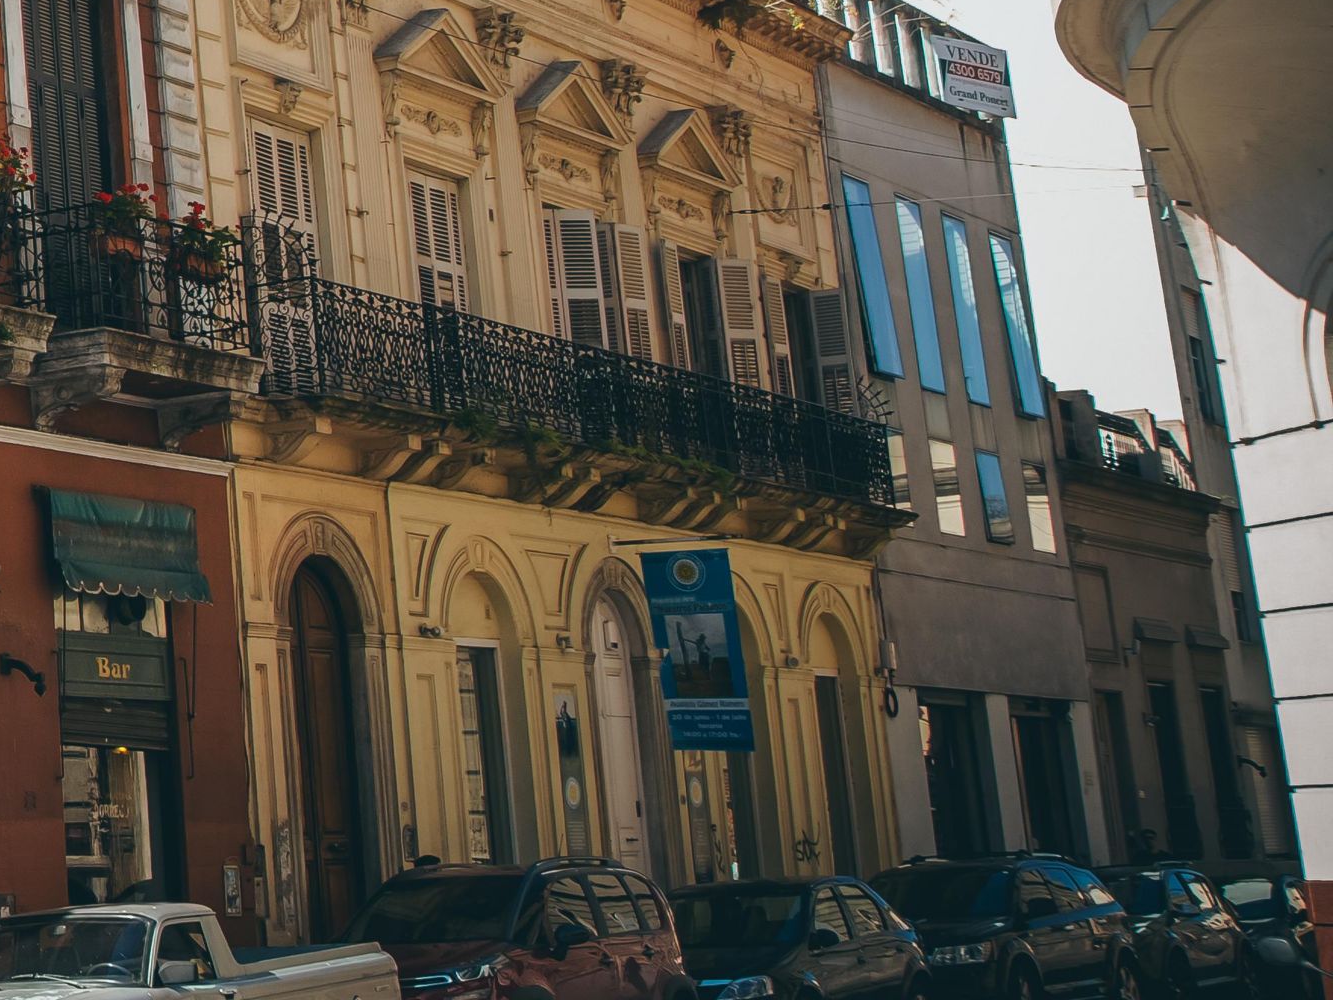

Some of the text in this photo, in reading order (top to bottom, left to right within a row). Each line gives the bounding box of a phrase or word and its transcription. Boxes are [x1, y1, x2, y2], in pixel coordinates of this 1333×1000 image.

[946, 45, 999, 68] VENDE
[948, 62, 1001, 83] 4300 6579
[949, 85, 978, 100] Grand
[95, 656, 131, 679] Bar
